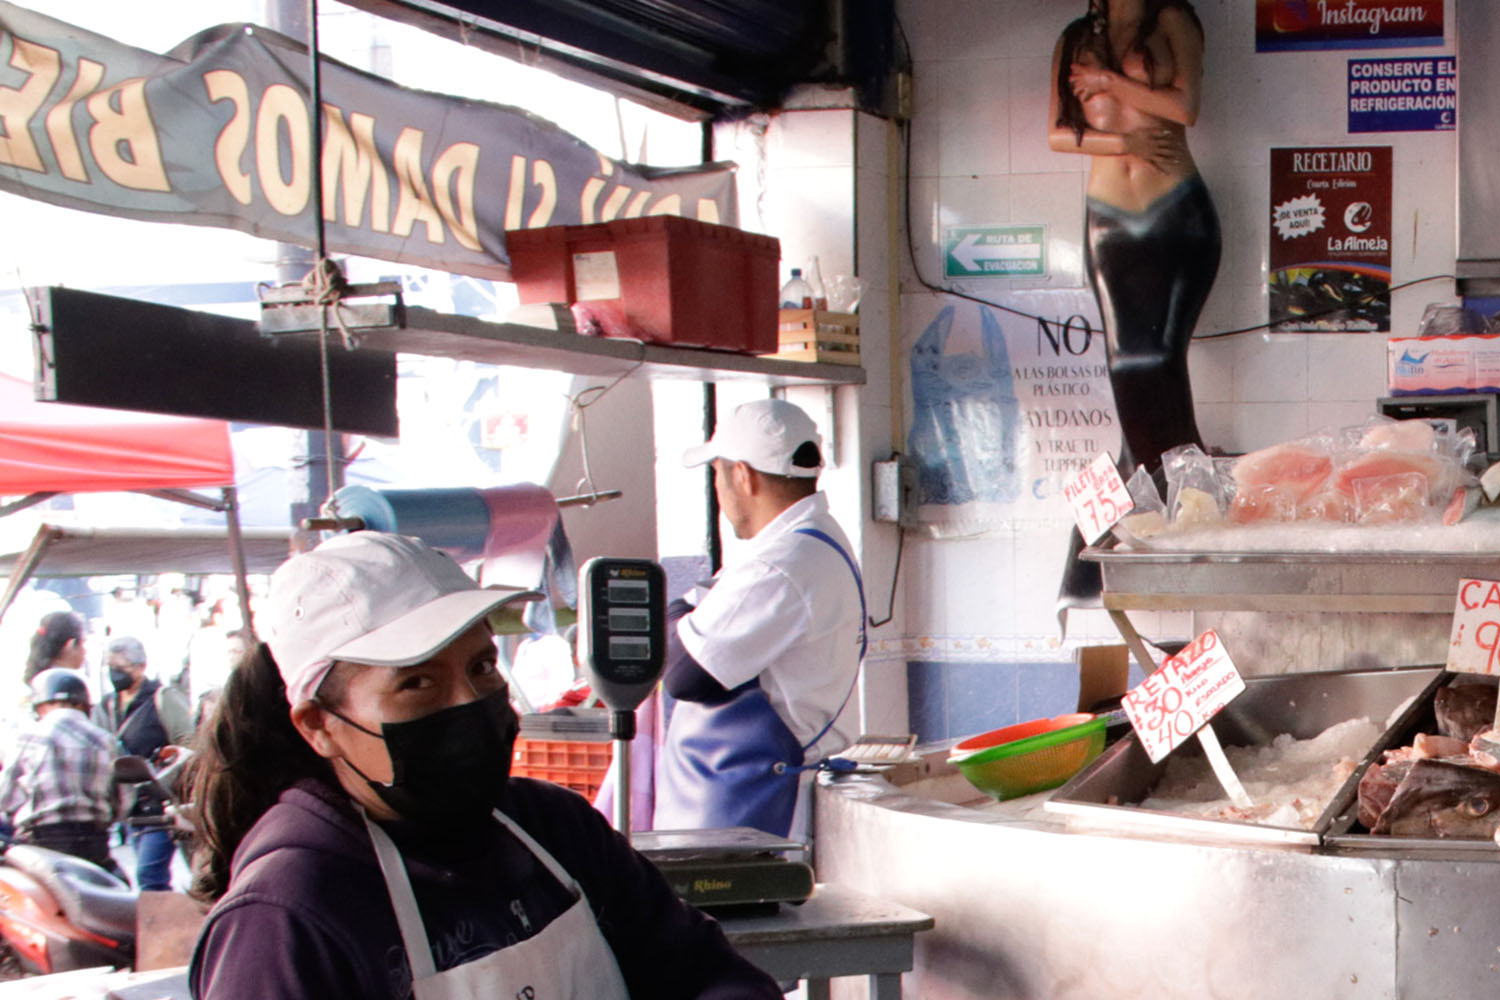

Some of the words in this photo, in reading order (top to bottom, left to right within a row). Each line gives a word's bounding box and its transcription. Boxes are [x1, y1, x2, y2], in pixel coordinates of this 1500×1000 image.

[1317, 0, 1427, 34] Instagram
[1351, 62, 1433, 77] CONSERVE
[1437, 61, 1456, 75] EL
[1351, 78, 1432, 94] PRODUCTO
[1436, 78, 1456, 91] EN
[1351, 94, 1456, 112] REFRIGERACIÓN
[1293, 151, 1373, 172] RECETARIO
[1293, 207, 1319, 217] VENTA
[1327, 236, 1342, 251] La
[1344, 236, 1389, 251] Almeja
[1036, 314, 1092, 356] NO
[1024, 366, 1044, 379] LAS
[1047, 365, 1091, 379] BOLSAS
[1126, 631, 1218, 711] RETAZO
[694, 880, 732, 893] Rhino
